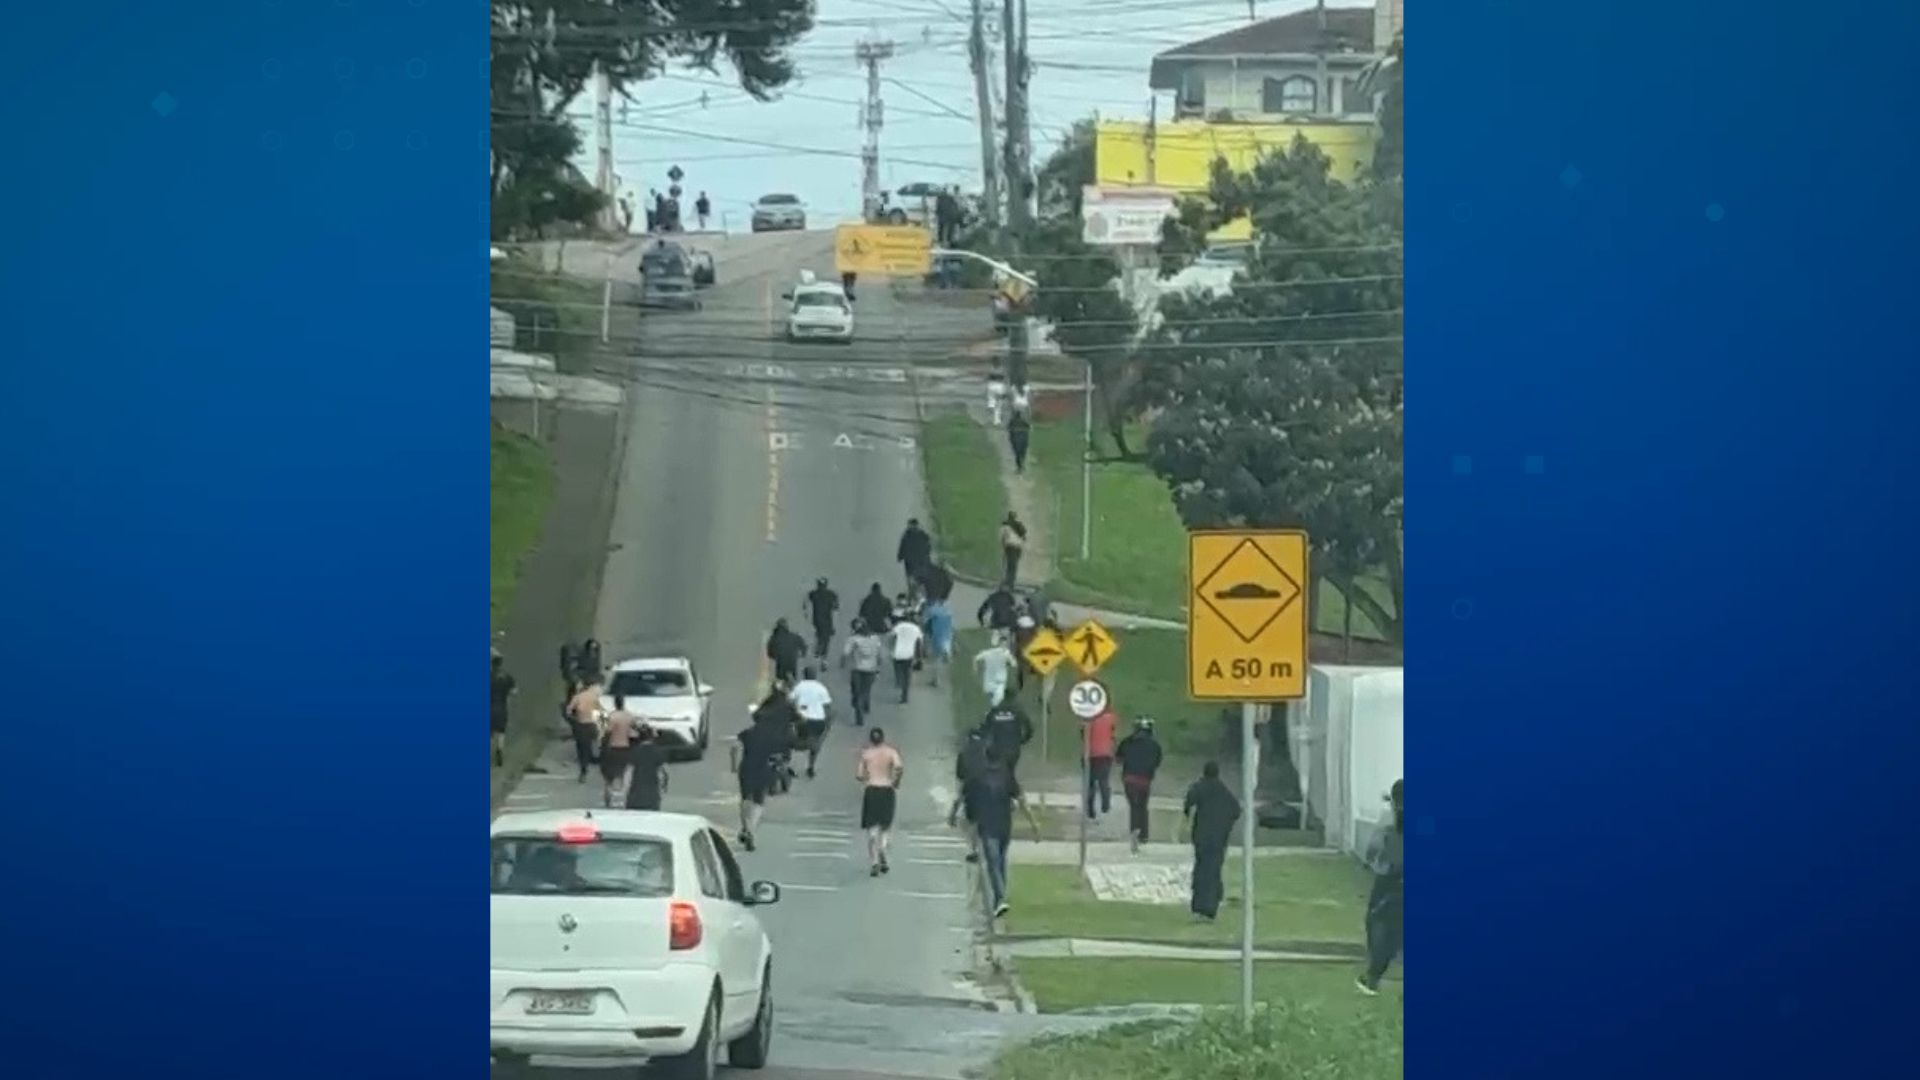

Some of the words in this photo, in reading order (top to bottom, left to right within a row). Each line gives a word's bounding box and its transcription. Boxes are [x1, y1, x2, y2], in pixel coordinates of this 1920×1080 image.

[1206, 660, 1223, 679] A
[1231, 658, 1262, 679] 50
[1270, 661, 1292, 678] m
[1074, 686, 1102, 705] 30
